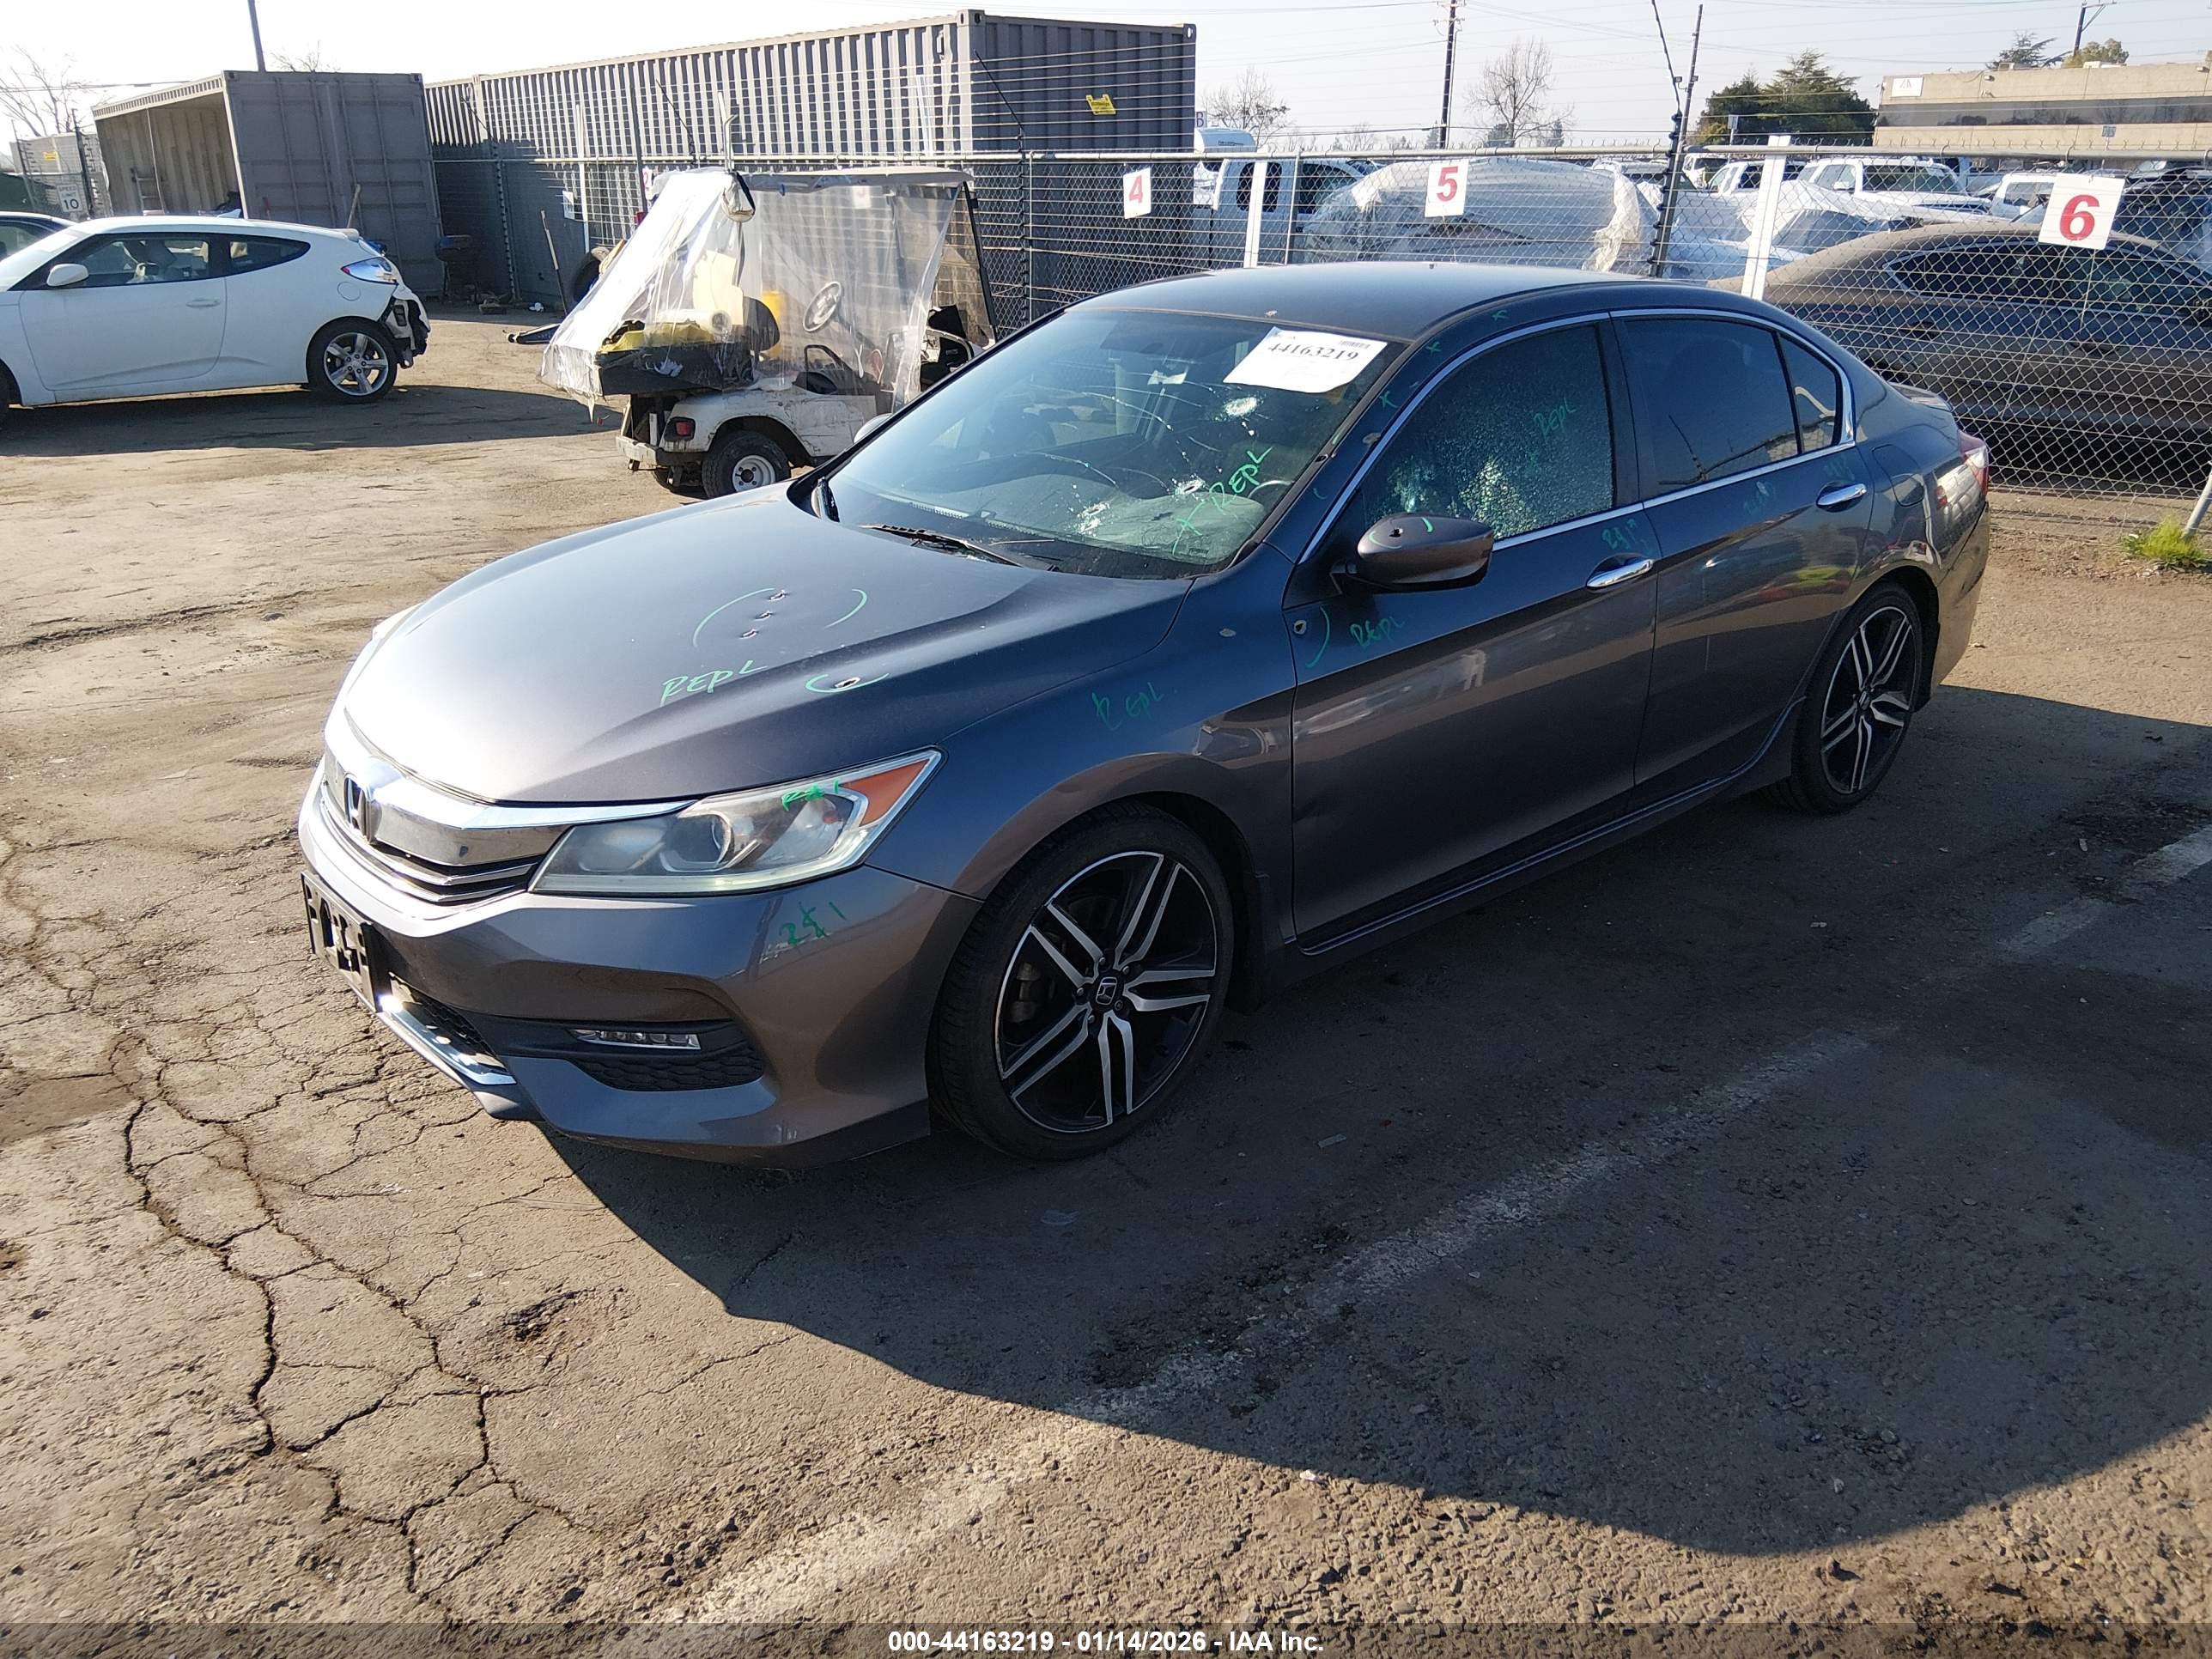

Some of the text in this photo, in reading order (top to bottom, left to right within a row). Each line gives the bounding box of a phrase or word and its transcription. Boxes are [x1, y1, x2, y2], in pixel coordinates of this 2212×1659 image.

[1128, 174, 1143, 204] 4
[1436, 165, 1458, 202] 5
[64, 198, 79, 210] 10
[2059, 194, 2100, 241] 6
[1267, 343, 1359, 362] 44163219
[659, 659, 769, 707] REPL
